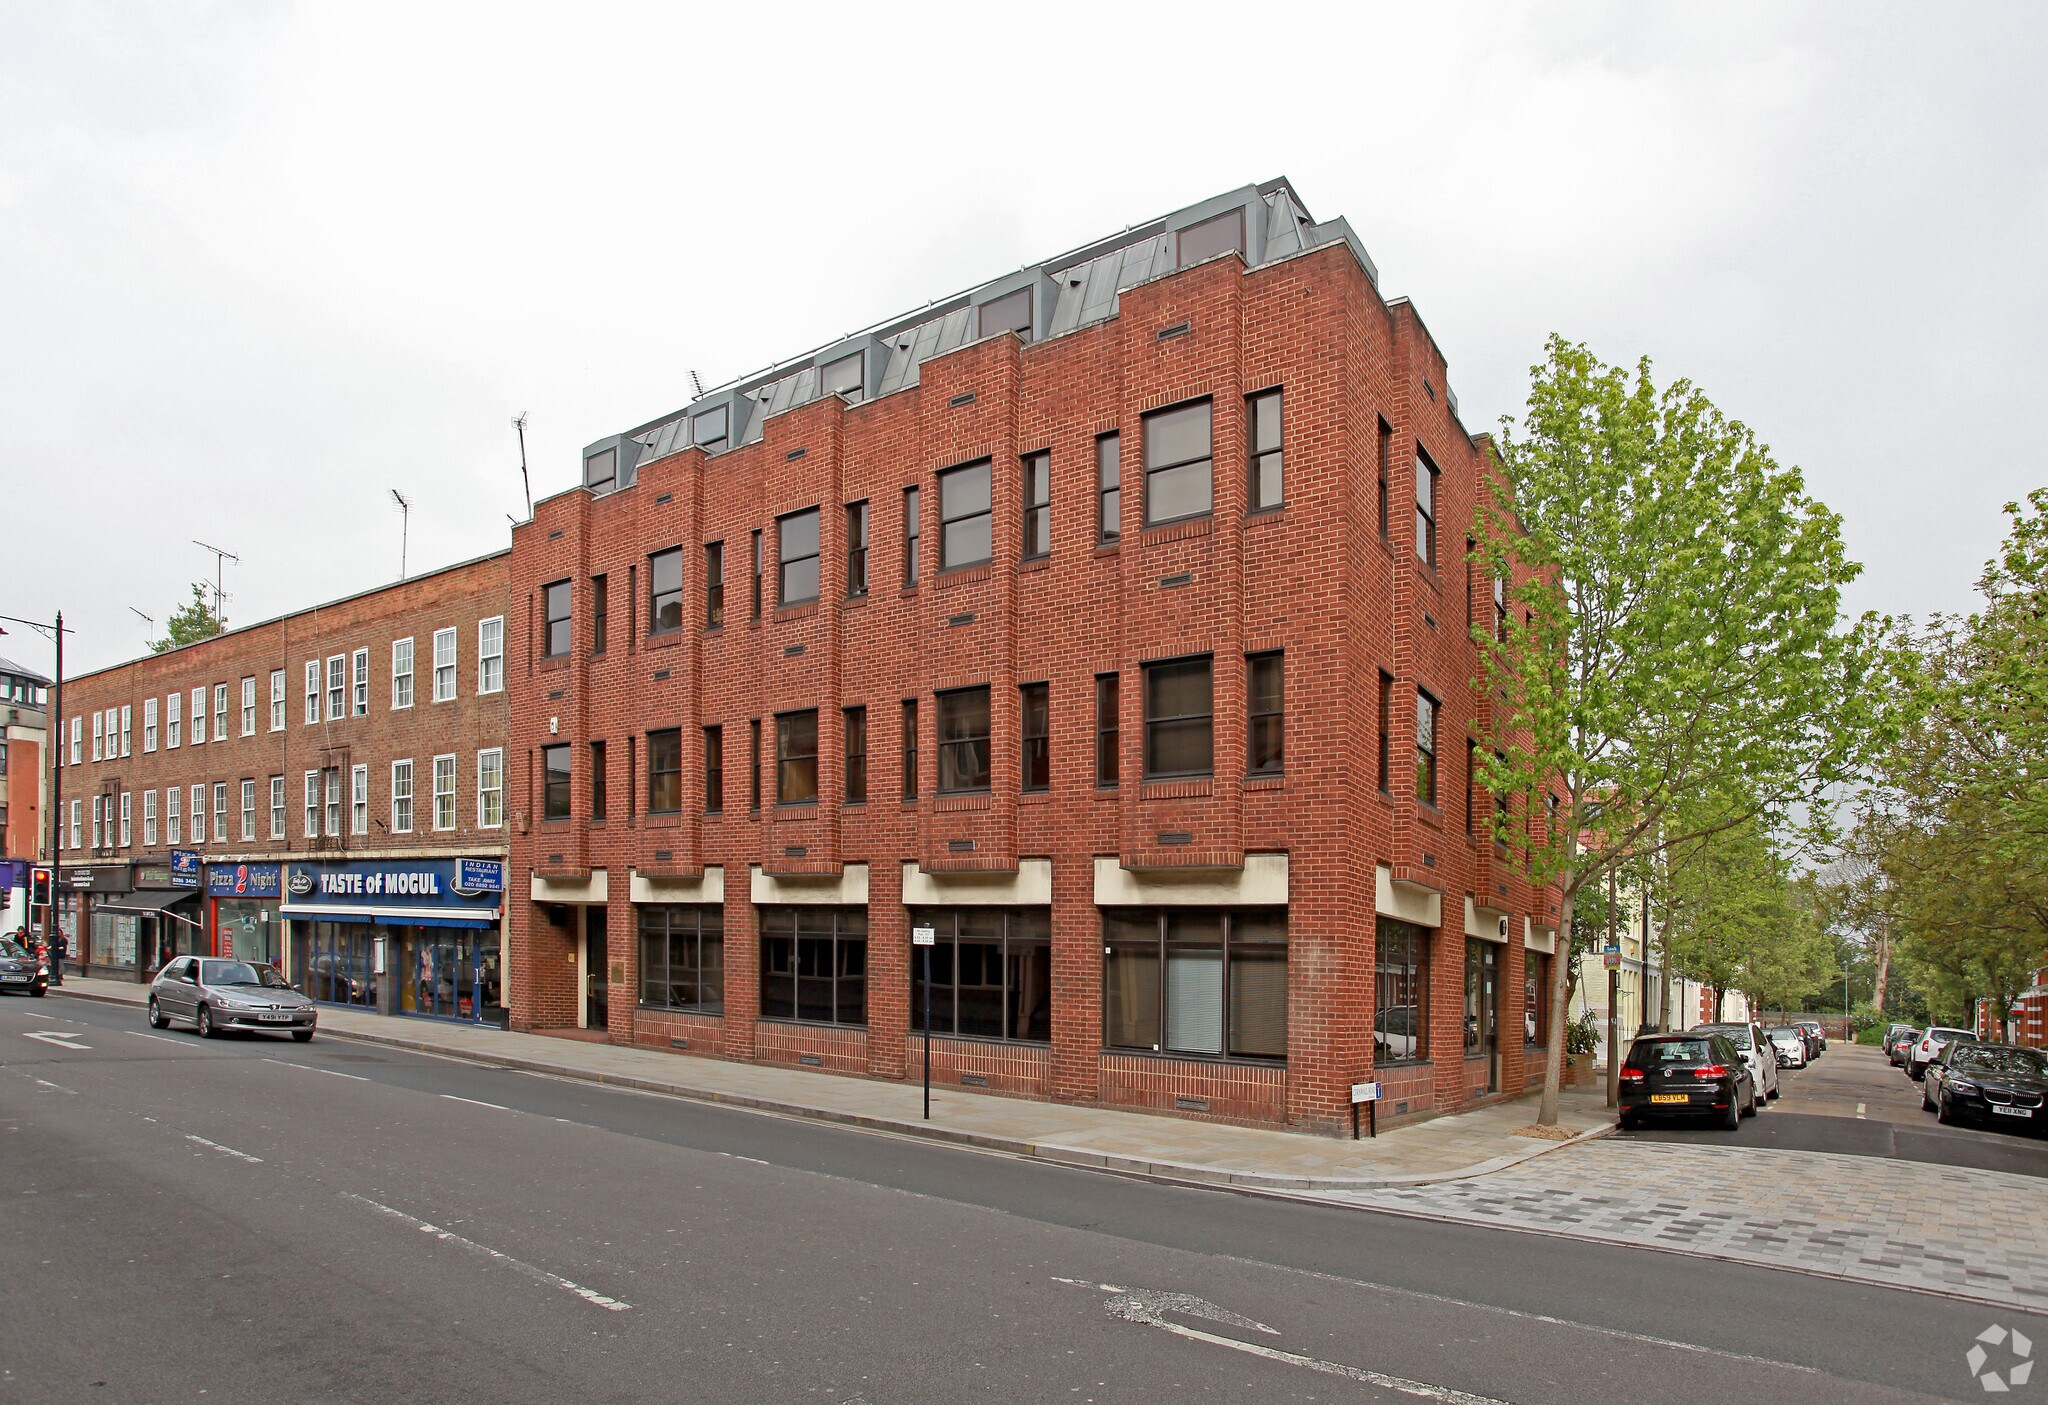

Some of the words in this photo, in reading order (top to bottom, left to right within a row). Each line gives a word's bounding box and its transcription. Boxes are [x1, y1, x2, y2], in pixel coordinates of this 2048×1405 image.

[465, 861, 498, 870] INDIAN
[465, 866, 498, 874] RESTAURANT
[210, 871, 235, 886] Pizza
[235, 864, 248, 894] 2
[250, 871, 277, 890] Night
[320, 873, 363, 894] TASTE
[366, 872, 383, 894] of
[385, 872, 439, 894] MOGUL
